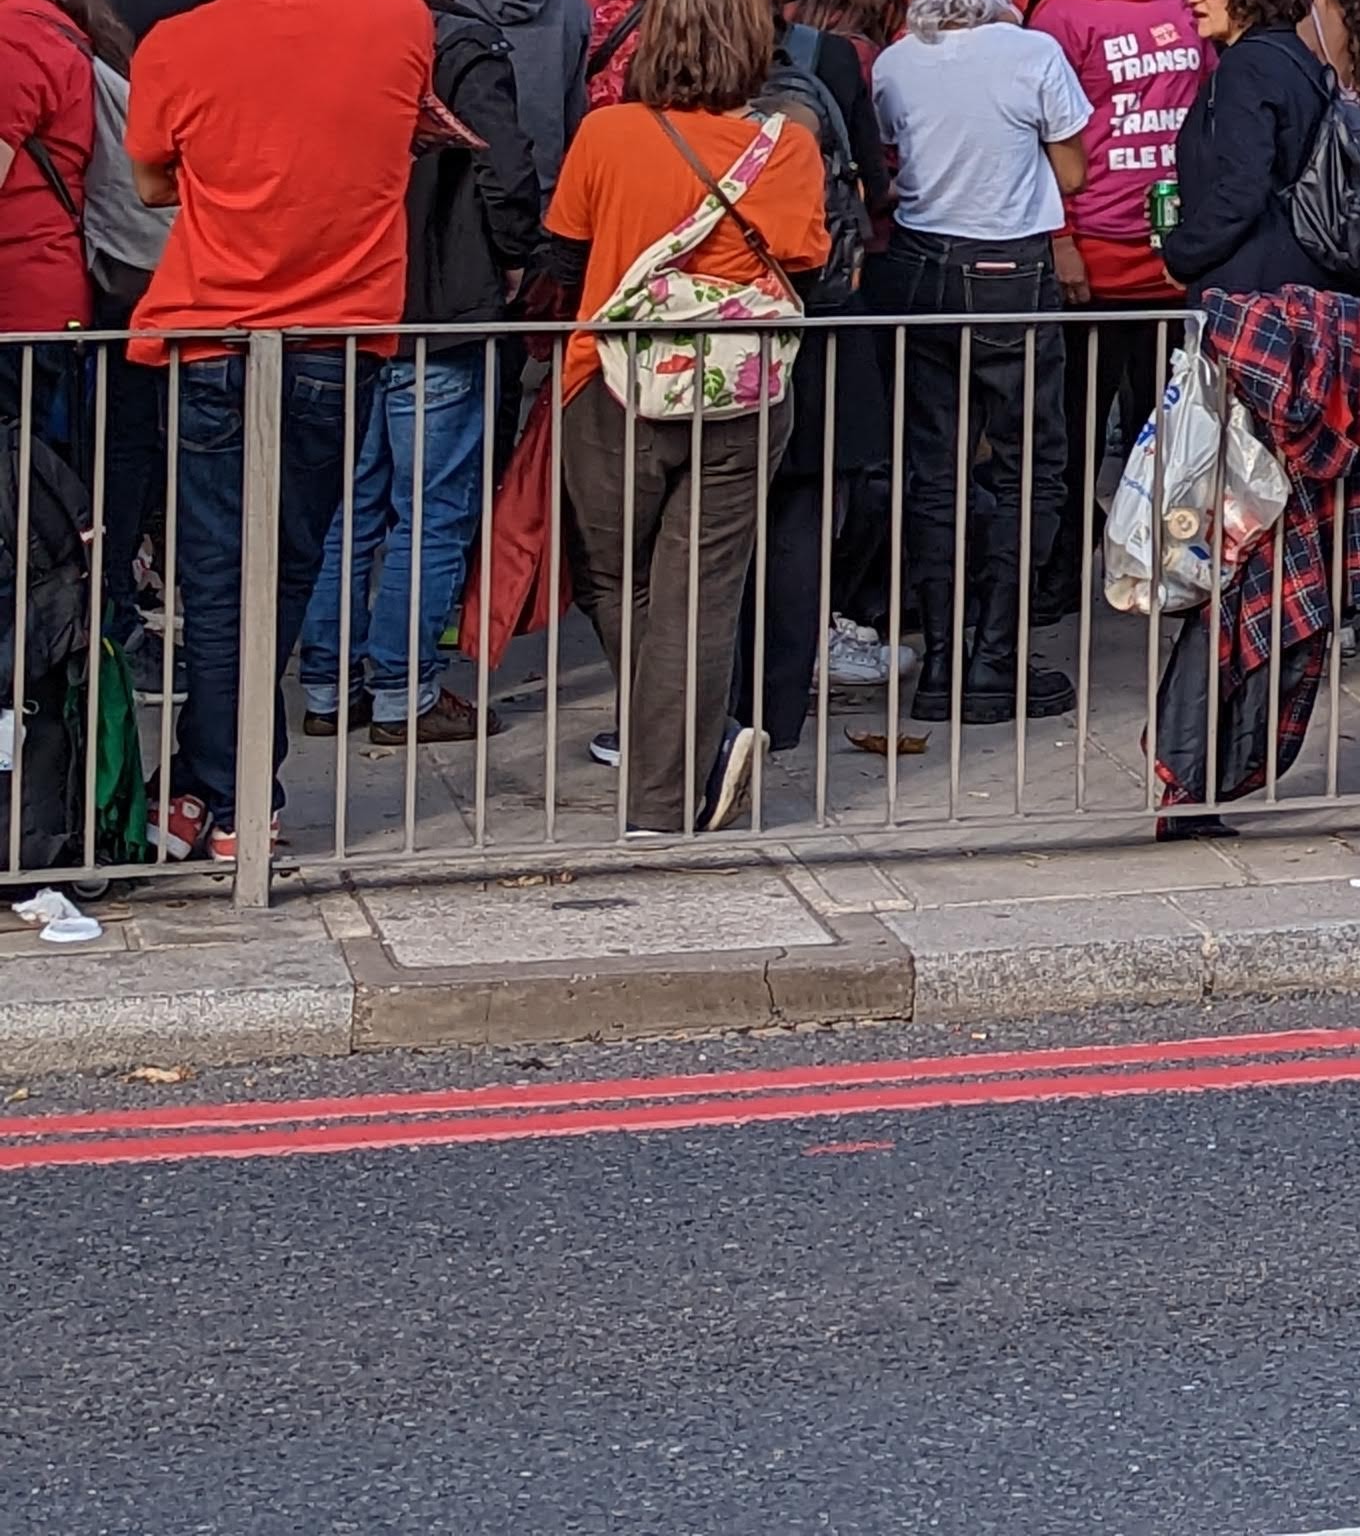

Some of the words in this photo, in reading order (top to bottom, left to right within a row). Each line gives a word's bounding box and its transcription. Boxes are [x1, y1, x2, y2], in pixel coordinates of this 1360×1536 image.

[1103, 33, 1139, 61] EU
[1107, 48, 1201, 84] TRANSO
[1108, 146, 1157, 171] ELE
